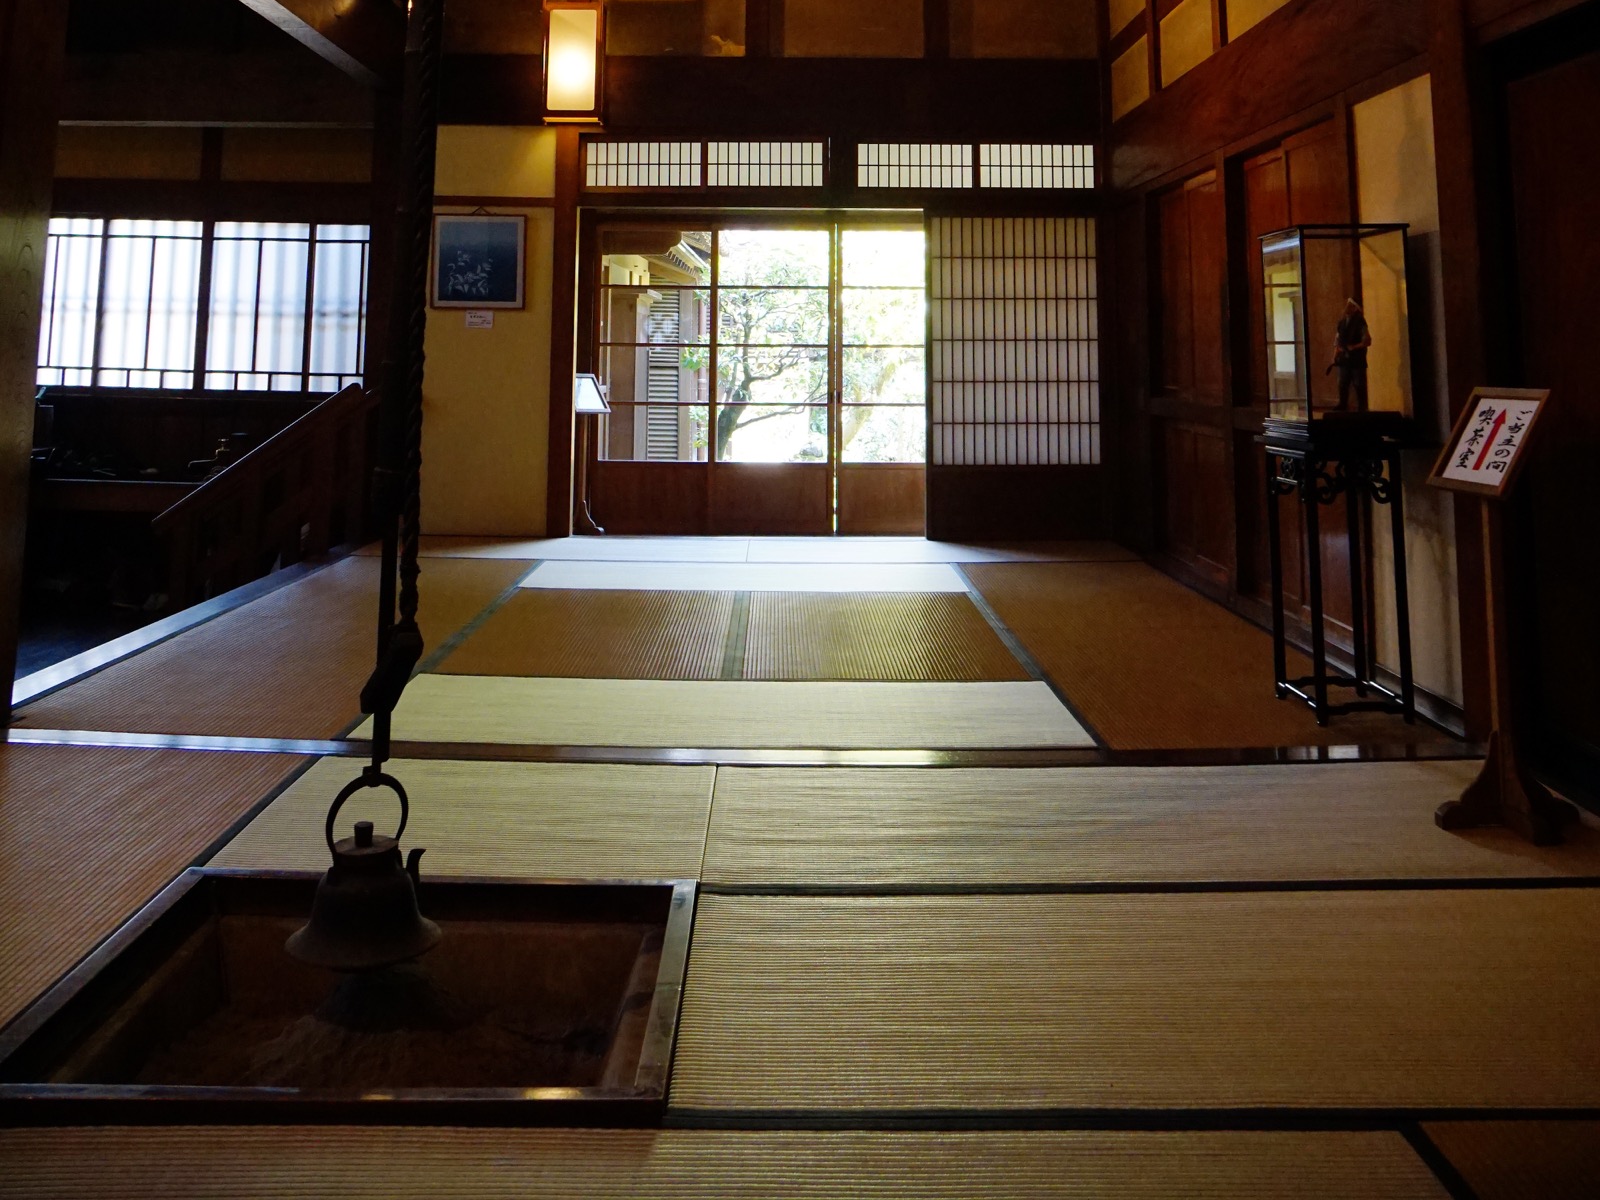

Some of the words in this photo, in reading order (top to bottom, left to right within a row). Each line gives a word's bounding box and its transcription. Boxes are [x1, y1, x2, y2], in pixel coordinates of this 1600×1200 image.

[1456, 406, 1496, 469] 喫茶室
[1486, 410, 1533, 473] ご当主の間
